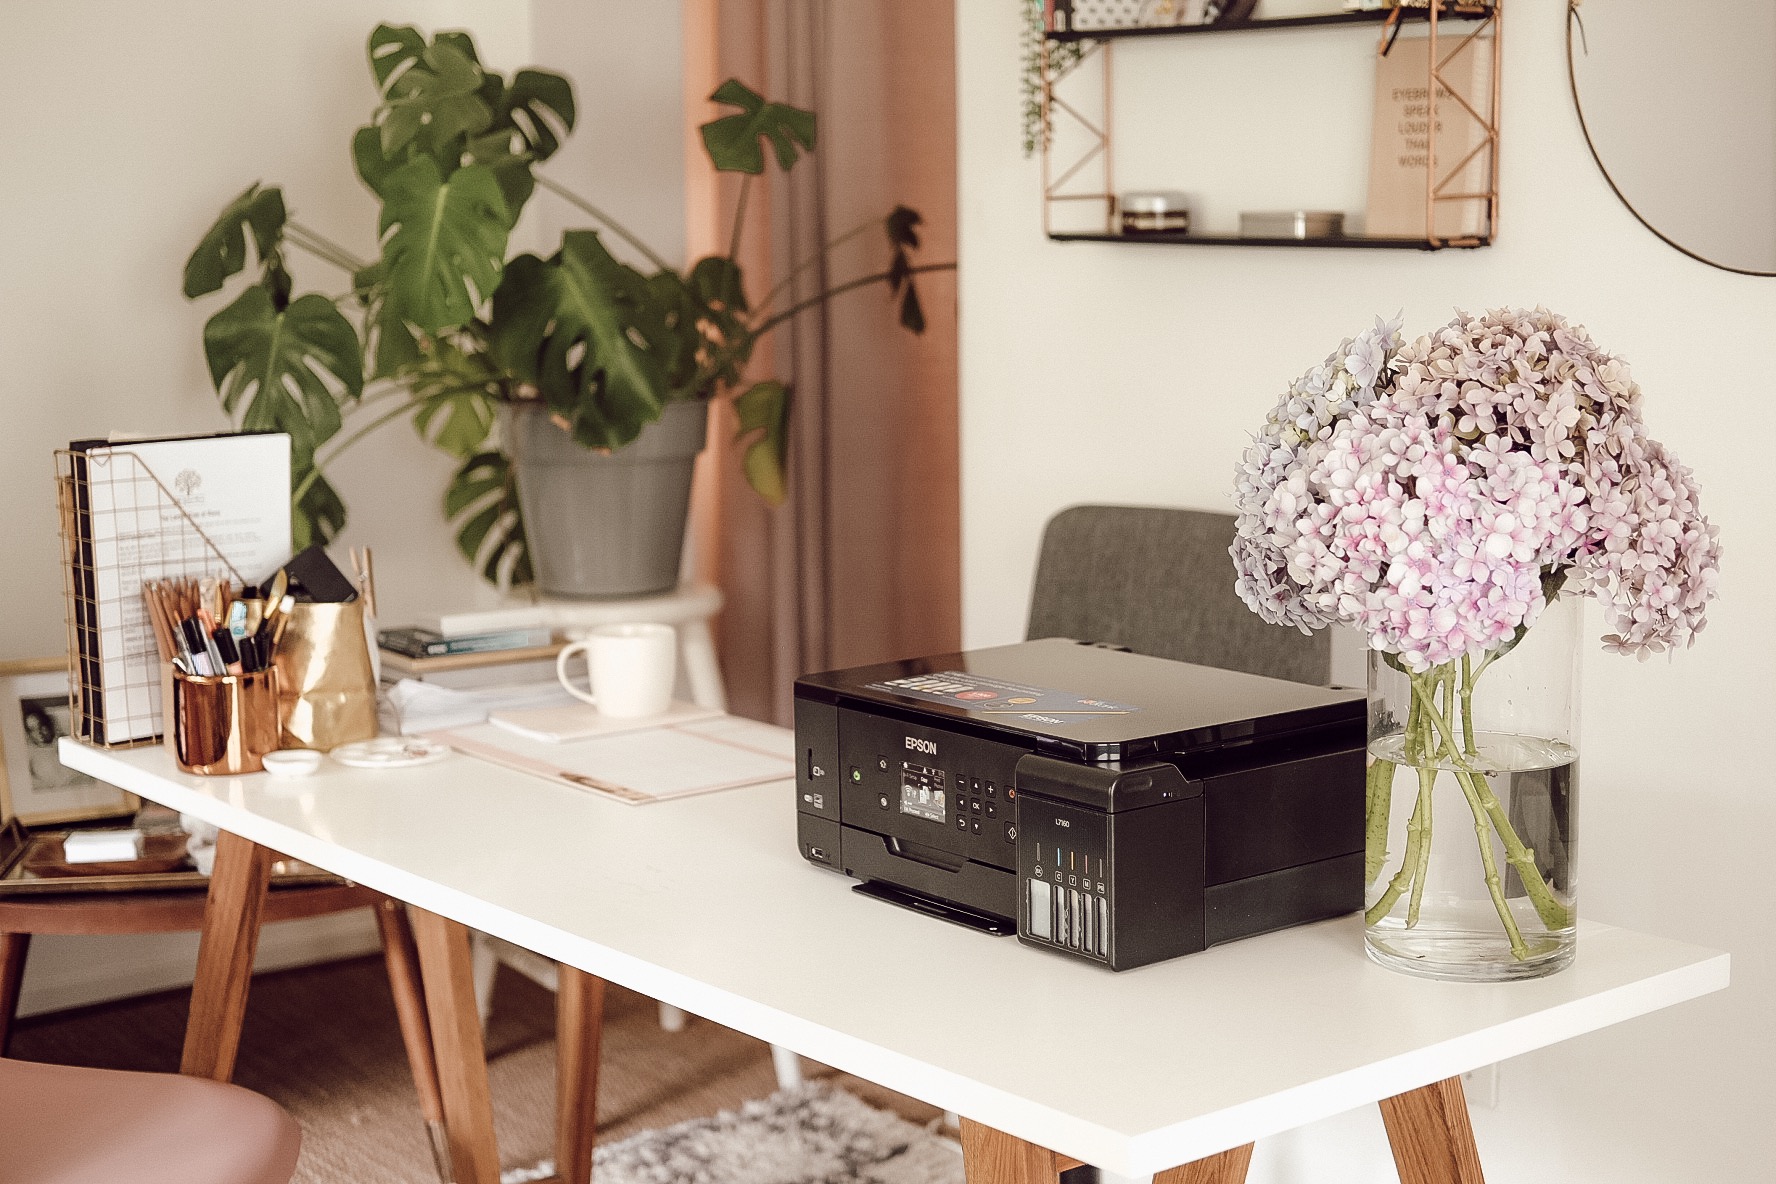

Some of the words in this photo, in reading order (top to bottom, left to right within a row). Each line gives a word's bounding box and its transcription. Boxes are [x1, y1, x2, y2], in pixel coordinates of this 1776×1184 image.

[1392, 88, 1452, 101] EYEBRWS
[905, 736, 937, 755] EPSON
[1055, 818, 1070, 828] L7160
